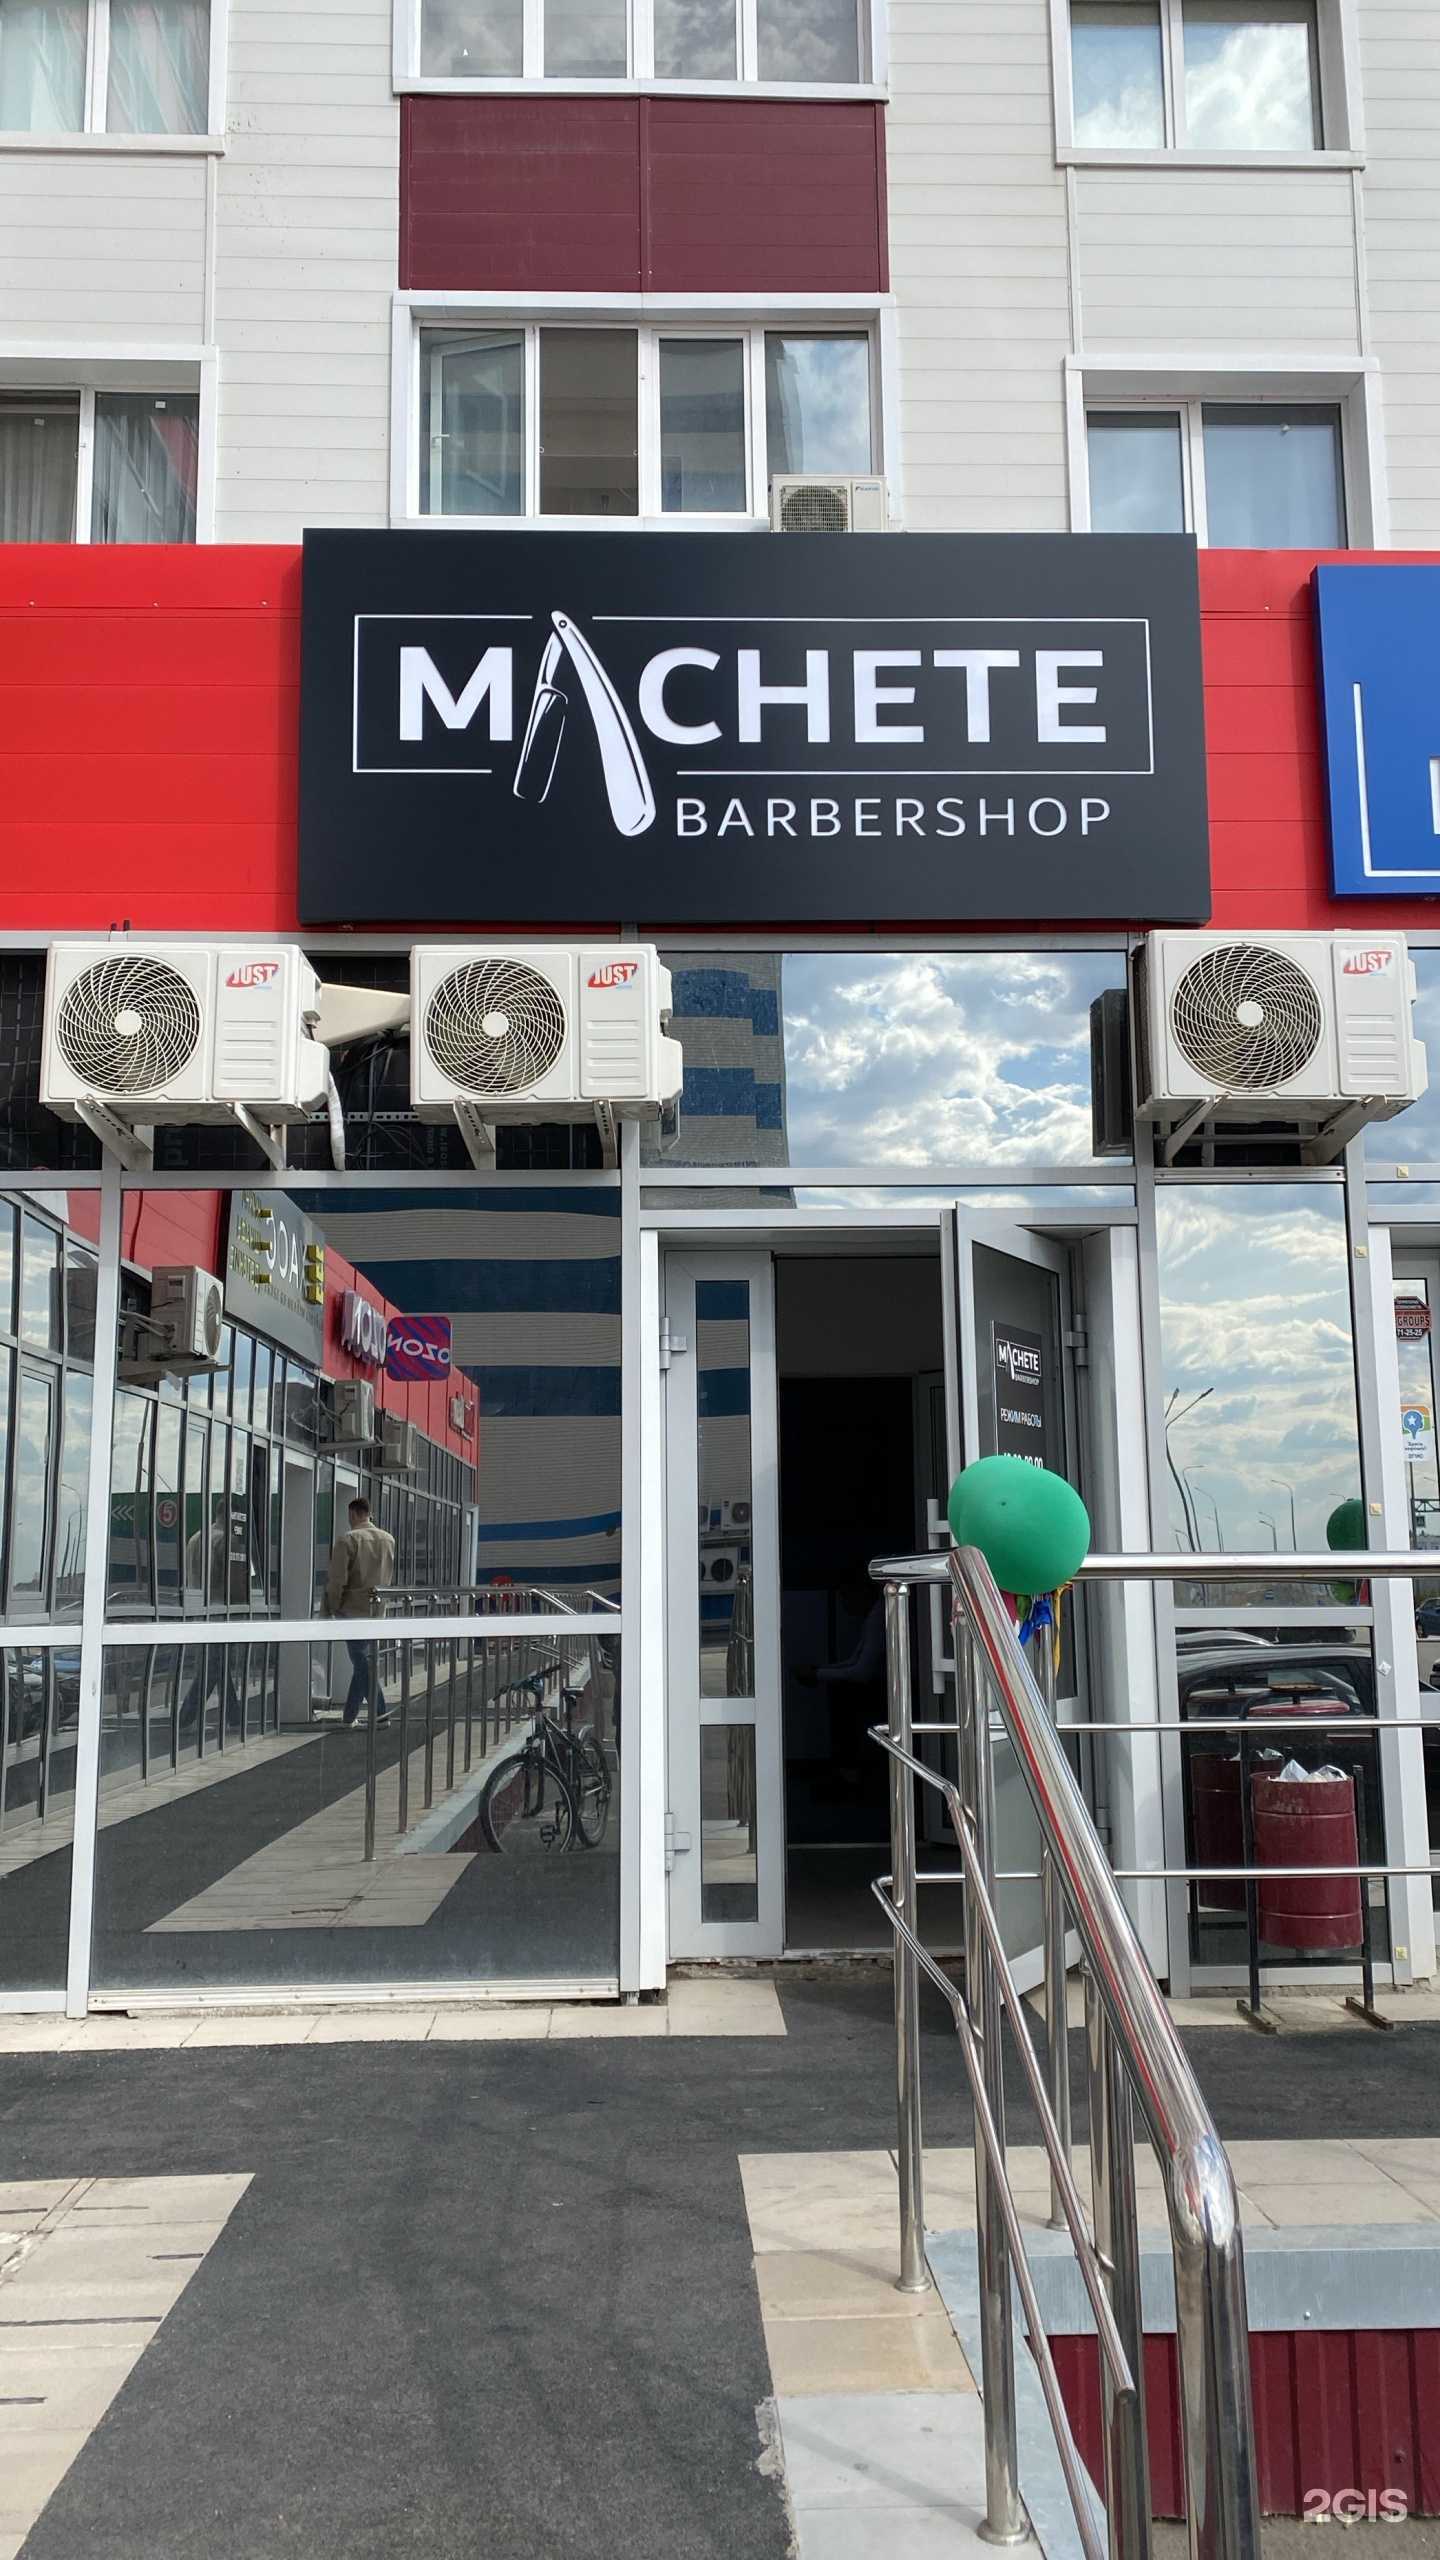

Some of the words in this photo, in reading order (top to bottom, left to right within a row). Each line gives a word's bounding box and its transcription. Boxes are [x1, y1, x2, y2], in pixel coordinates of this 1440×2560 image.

[676, 797, 1112, 838] BARBERSHOP
[1347, 952, 1389, 972] JUST
[231, 965, 276, 985] JUST
[592, 965, 635, 985] JUST
[1000, 1407, 1021, 1424] РЕЖИМ
[1021, 1411, 1042, 1428] РАБОТЫ
